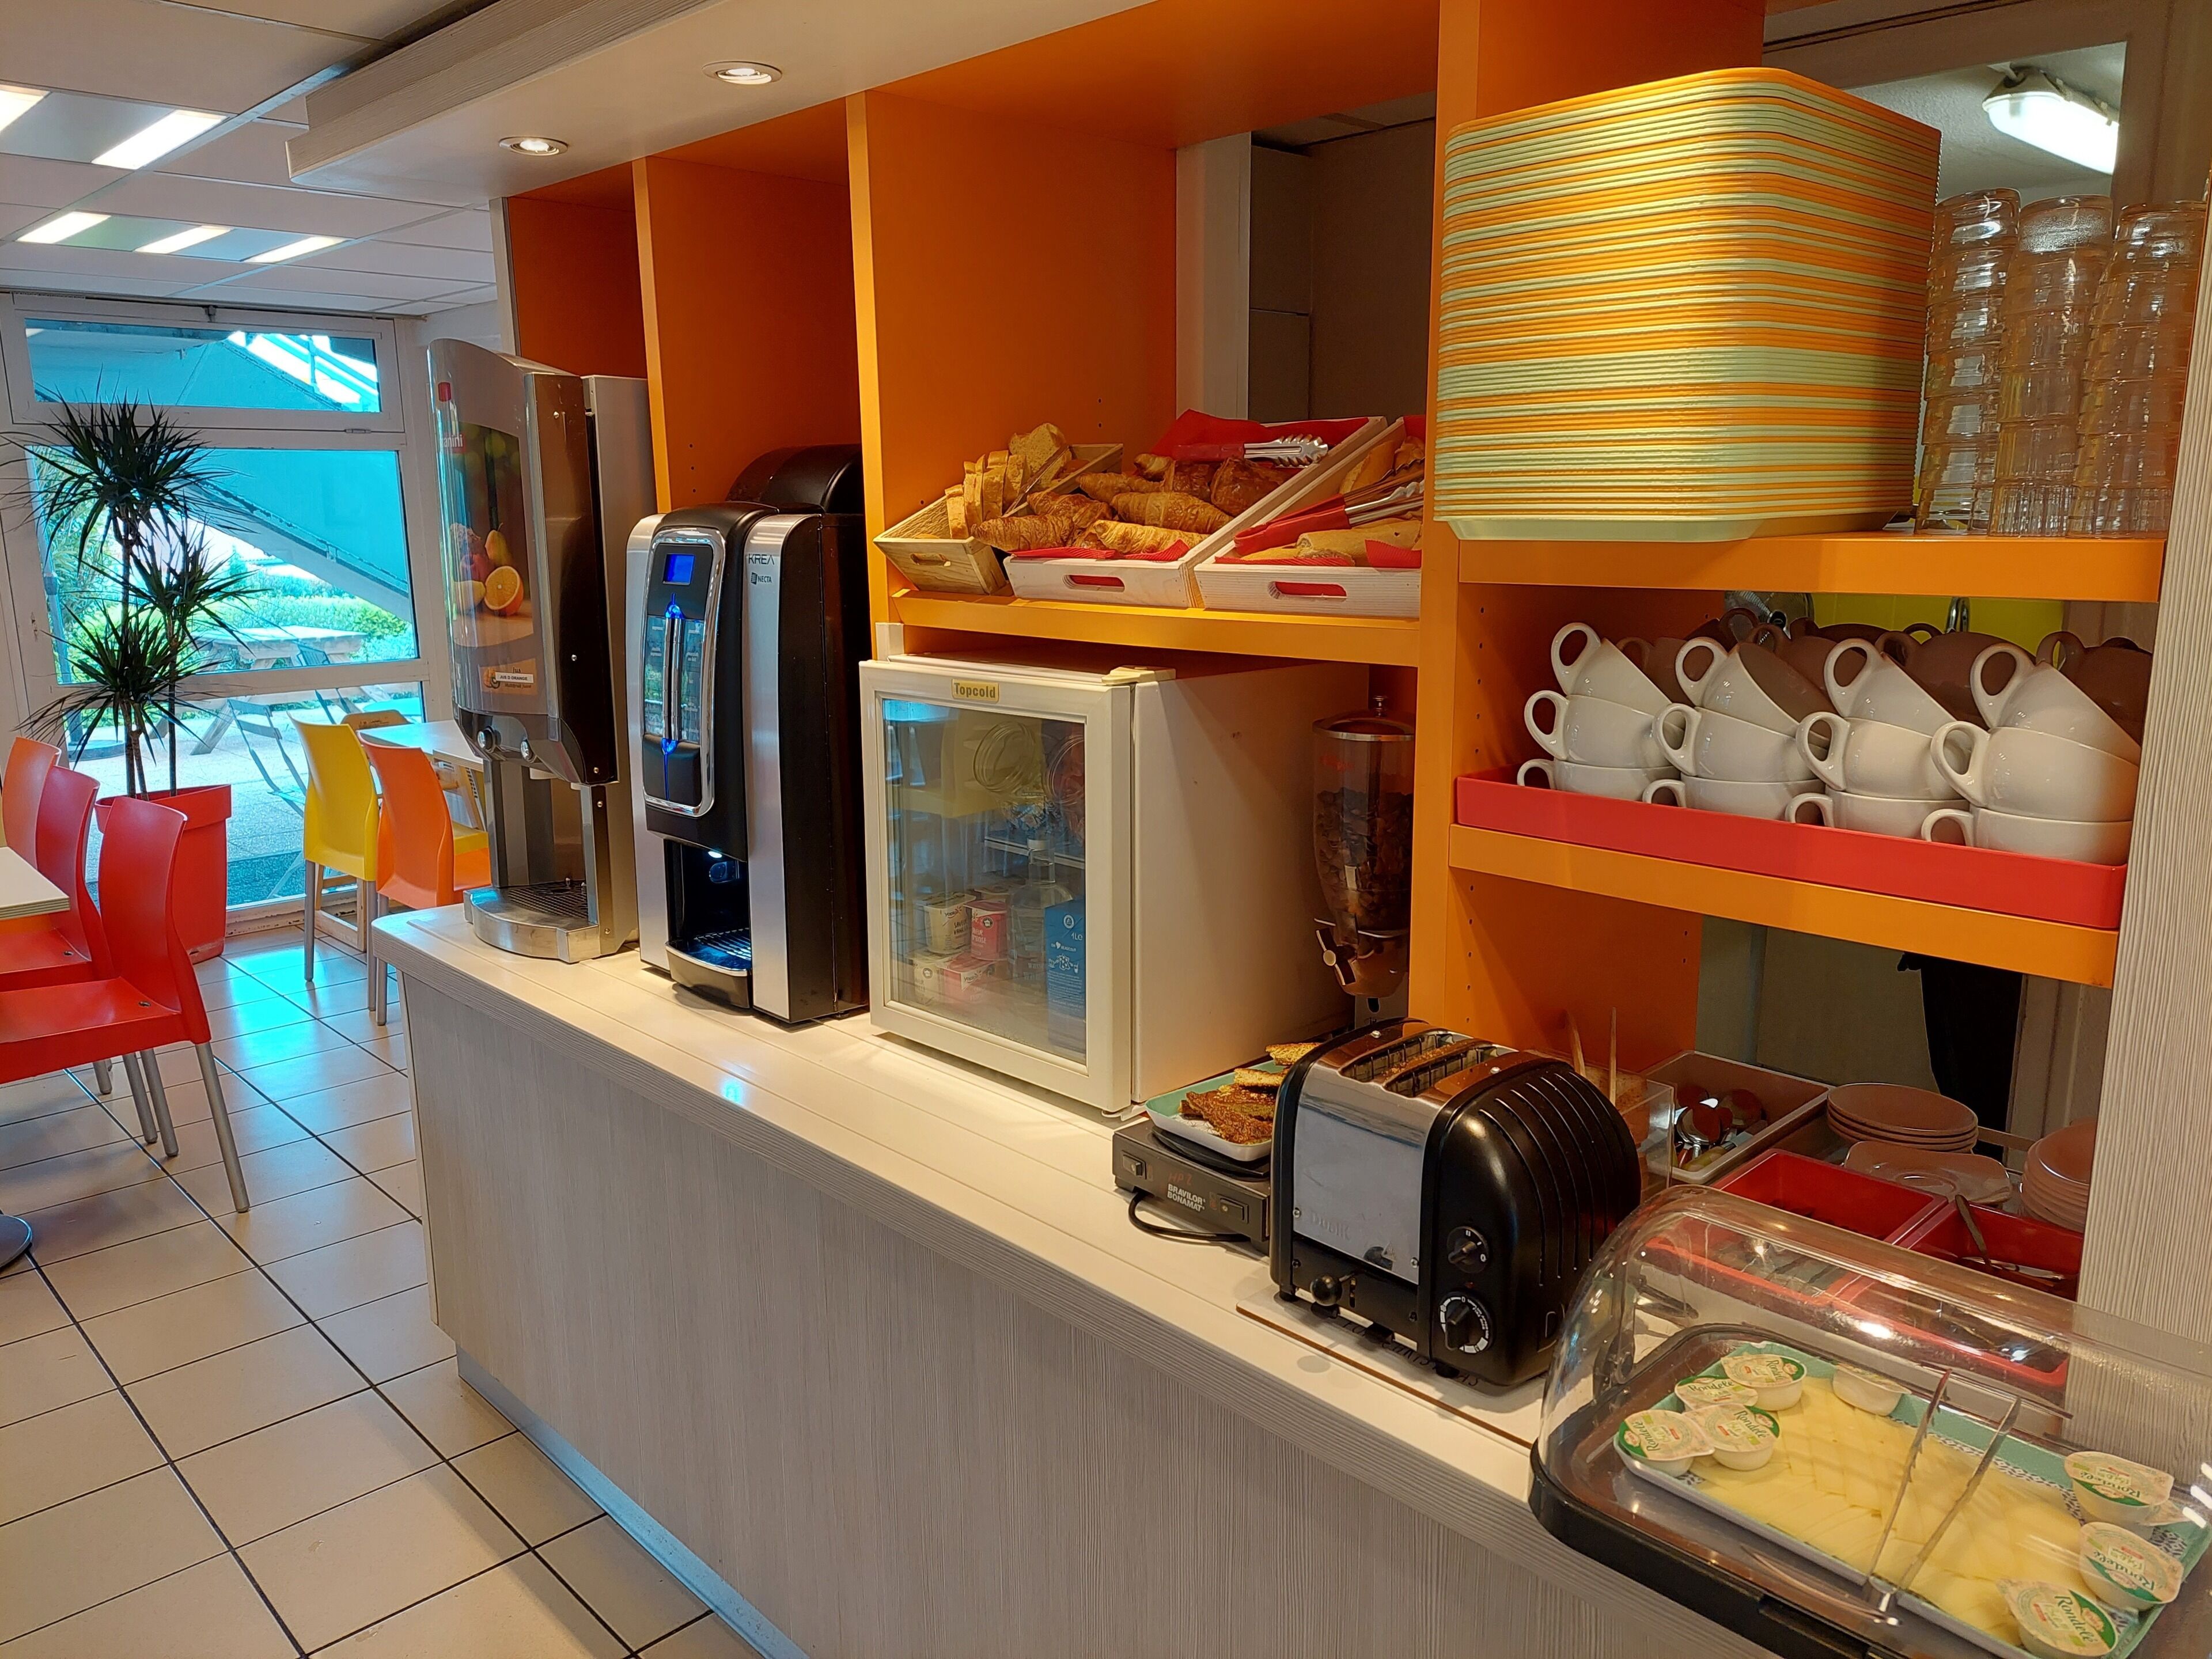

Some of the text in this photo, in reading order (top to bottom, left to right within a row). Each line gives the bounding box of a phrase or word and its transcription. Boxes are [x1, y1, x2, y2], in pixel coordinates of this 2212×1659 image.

[954, 683, 995, 698] Topcold
[1167, 1191, 1202, 1212] BONAMAT
[1168, 1183, 1203, 1204] BRAVILOR
[1733, 1410, 1770, 1438] Rondelé
[1632, 1421, 1661, 1452] Rondelé
[2054, 1595, 2098, 1643] Rondelé
